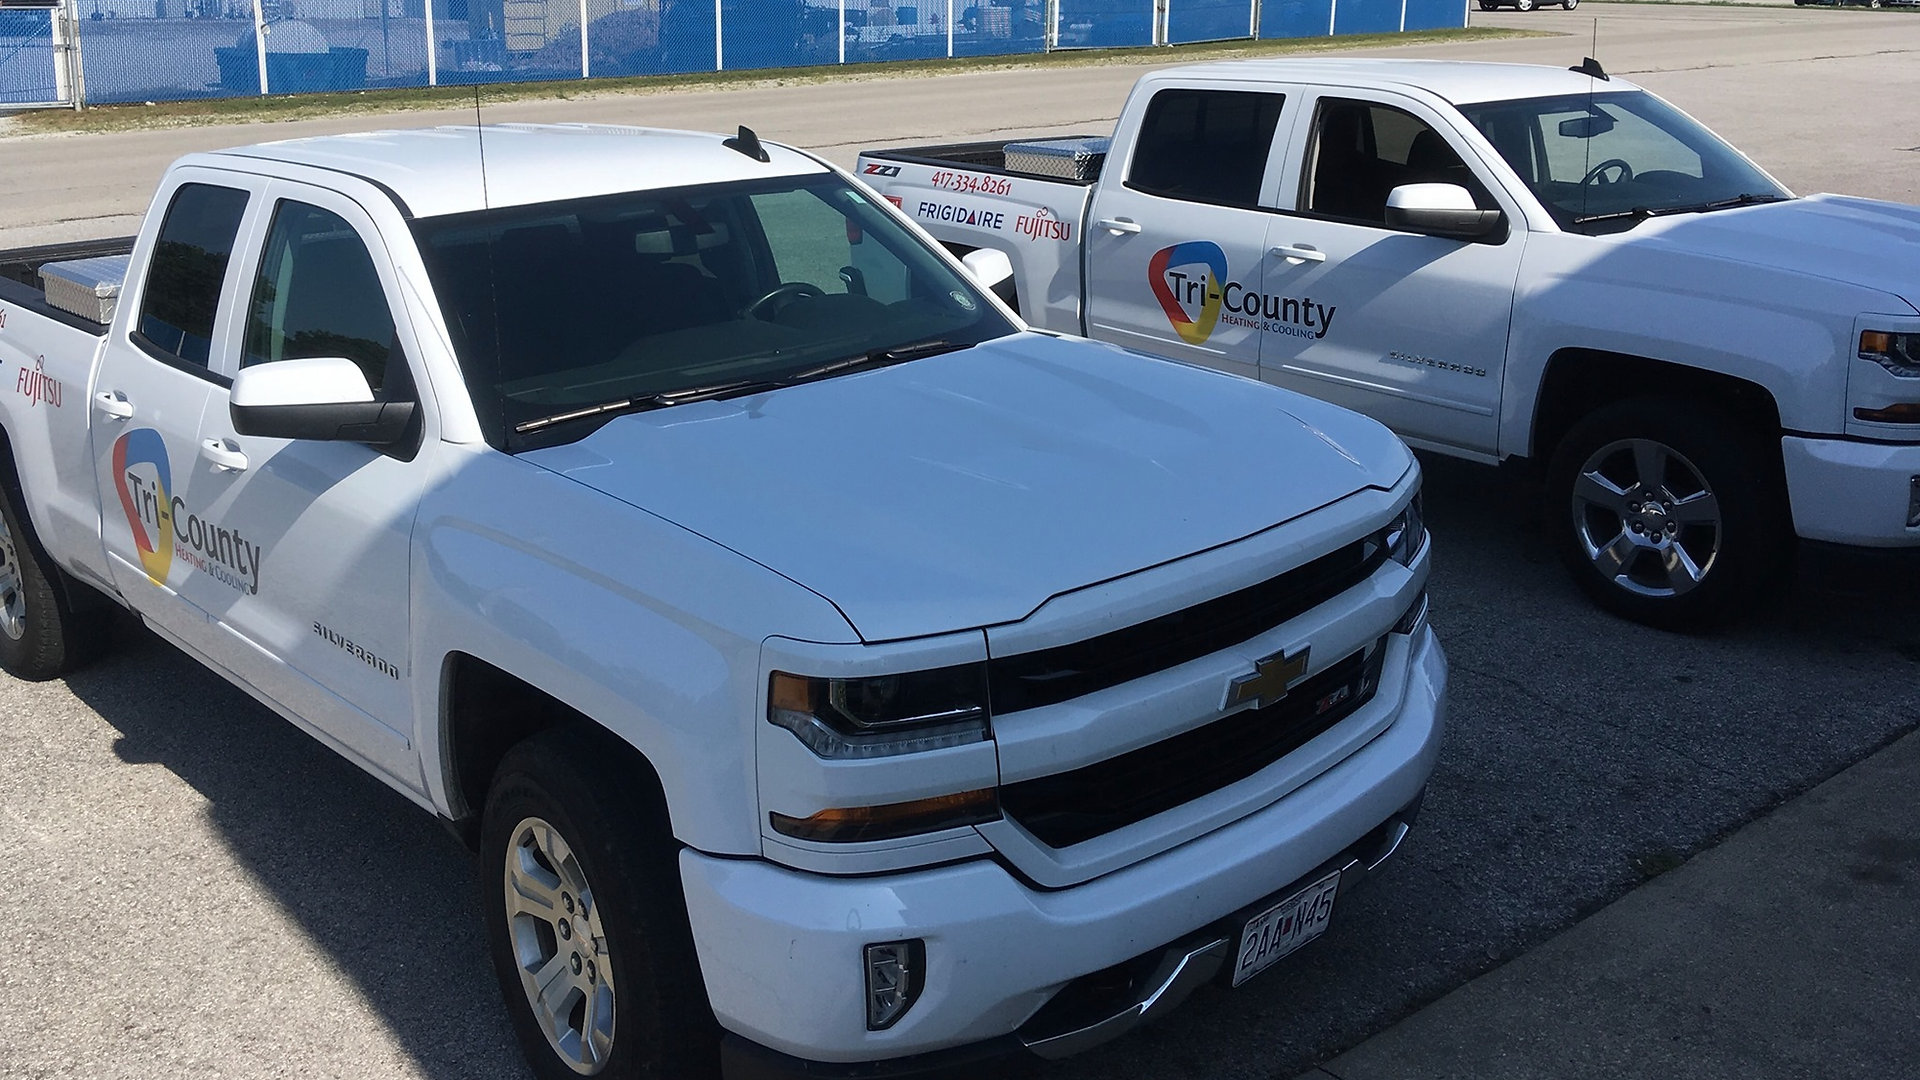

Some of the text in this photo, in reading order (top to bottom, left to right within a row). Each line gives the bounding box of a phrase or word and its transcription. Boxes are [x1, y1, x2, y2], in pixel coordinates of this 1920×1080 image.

[863, 163, 901, 177] Z71
[931, 171, 1012, 196] 417.334.8261
[918, 202, 1005, 230] FRIGIDAIRE
[1015, 213, 1071, 241] FUJITSU
[1169, 271, 1337, 340] Tri-County
[1221, 313, 1314, 340] HEATING & COOLING
[16, 366, 62, 408] FUJITSU
[128, 472, 261, 596] Tri-County
[175, 542, 250, 596] HEATING & COOLING
[313, 620, 399, 680] SILVERADO
